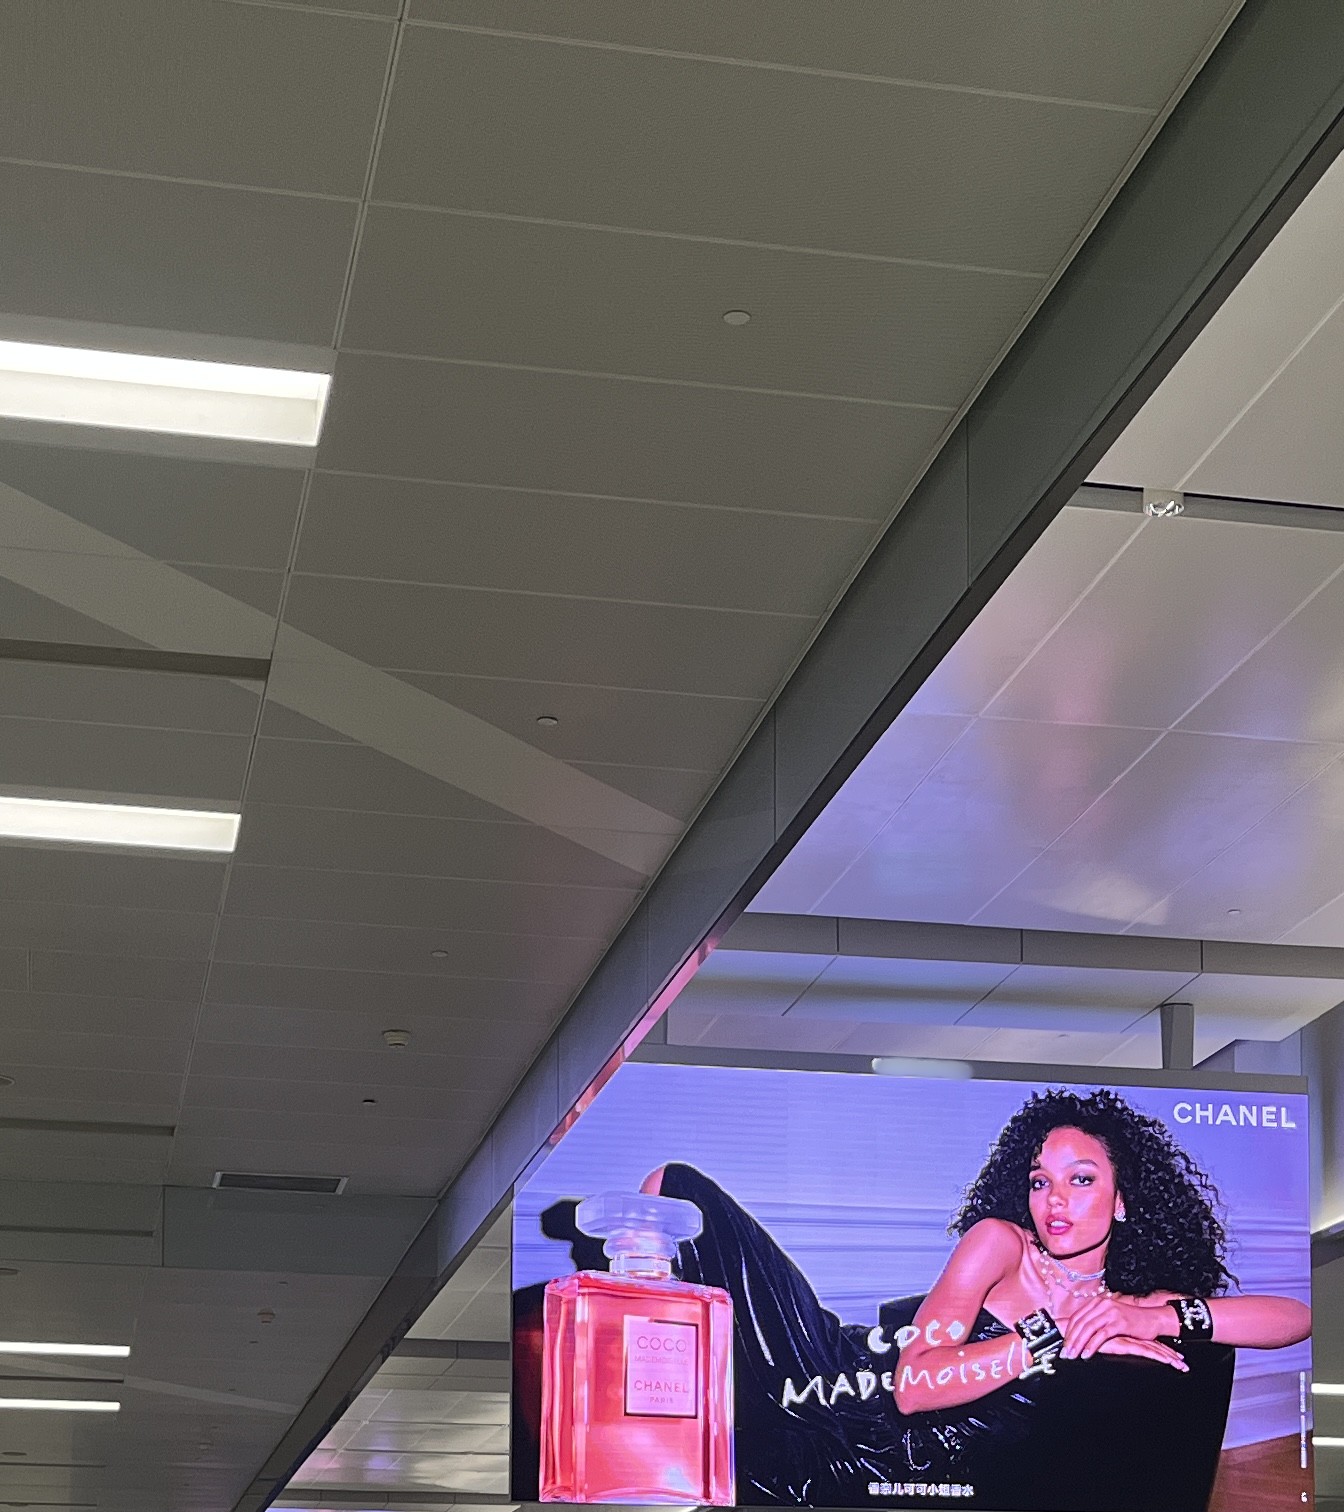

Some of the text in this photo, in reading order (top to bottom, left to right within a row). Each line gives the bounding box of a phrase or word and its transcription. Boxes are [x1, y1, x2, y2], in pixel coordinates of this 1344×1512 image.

[1173, 1102, 1296, 1129] CHANEL
[636, 1336, 687, 1353] COCO
[867, 1319, 965, 1354] COCO
[633, 1379, 689, 1394] CHANEL
